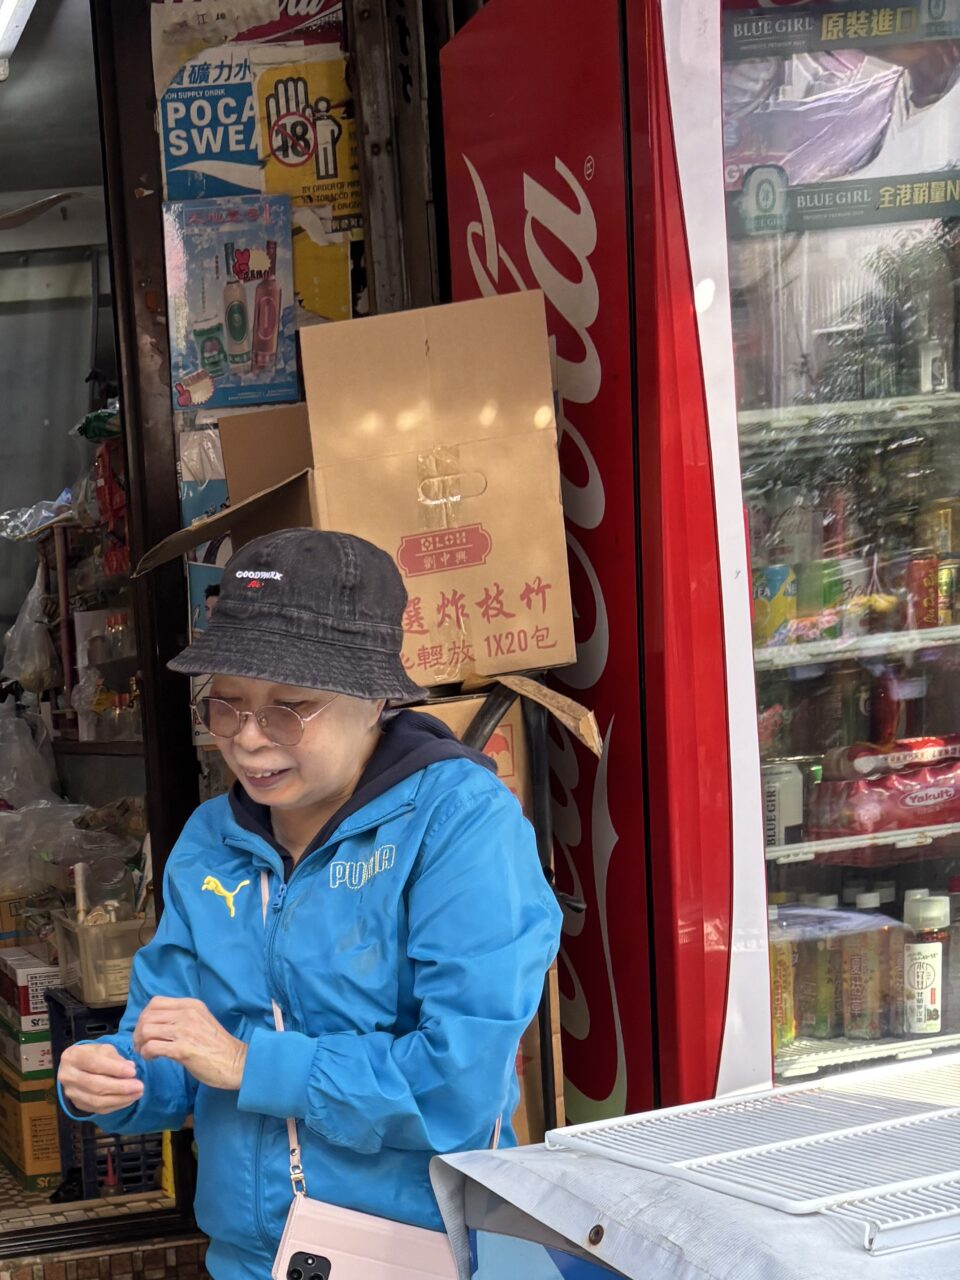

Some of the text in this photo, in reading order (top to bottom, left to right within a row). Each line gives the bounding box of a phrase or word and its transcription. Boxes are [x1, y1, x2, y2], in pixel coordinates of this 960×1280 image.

[733, 17, 813, 37] BLUE GIRL
[821, 7, 918, 41] 原裝進口
[178, 90, 204, 99] SUPPLY
[274, 120, 311, 158] 18
[796, 189, 871, 209] BLUE GIRL
[483, 625, 558, 658] 1X20包
[909, 789, 952, 804] Yakult
[766, 815, 777, 847] BLUE
[329, 844, 396, 890] PUMA
